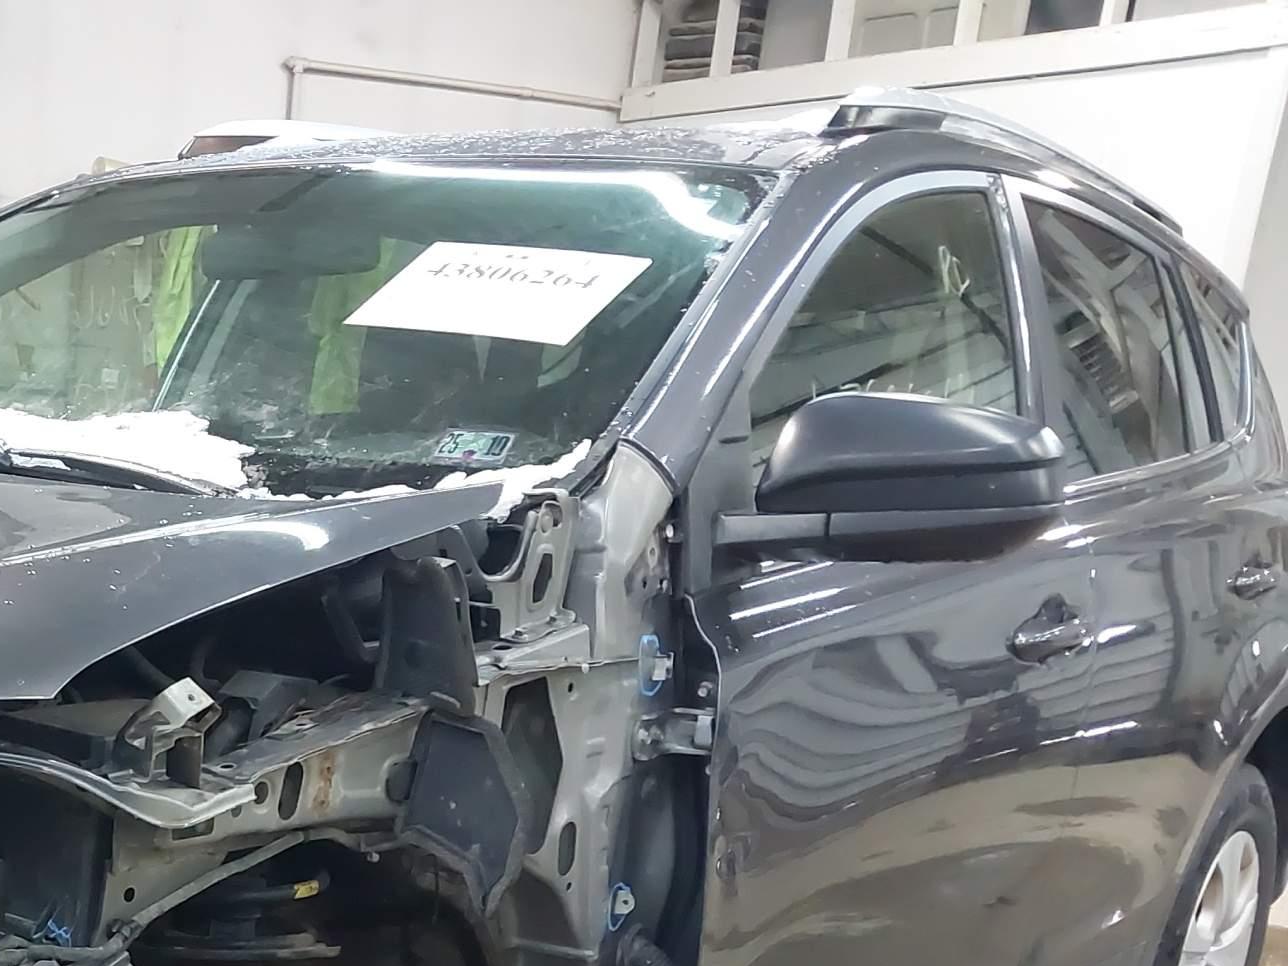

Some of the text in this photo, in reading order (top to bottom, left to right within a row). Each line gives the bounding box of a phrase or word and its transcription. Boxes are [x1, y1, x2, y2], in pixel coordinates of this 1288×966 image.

[427, 263, 601, 289] 43806264
[438, 433, 511, 456] 25 10
